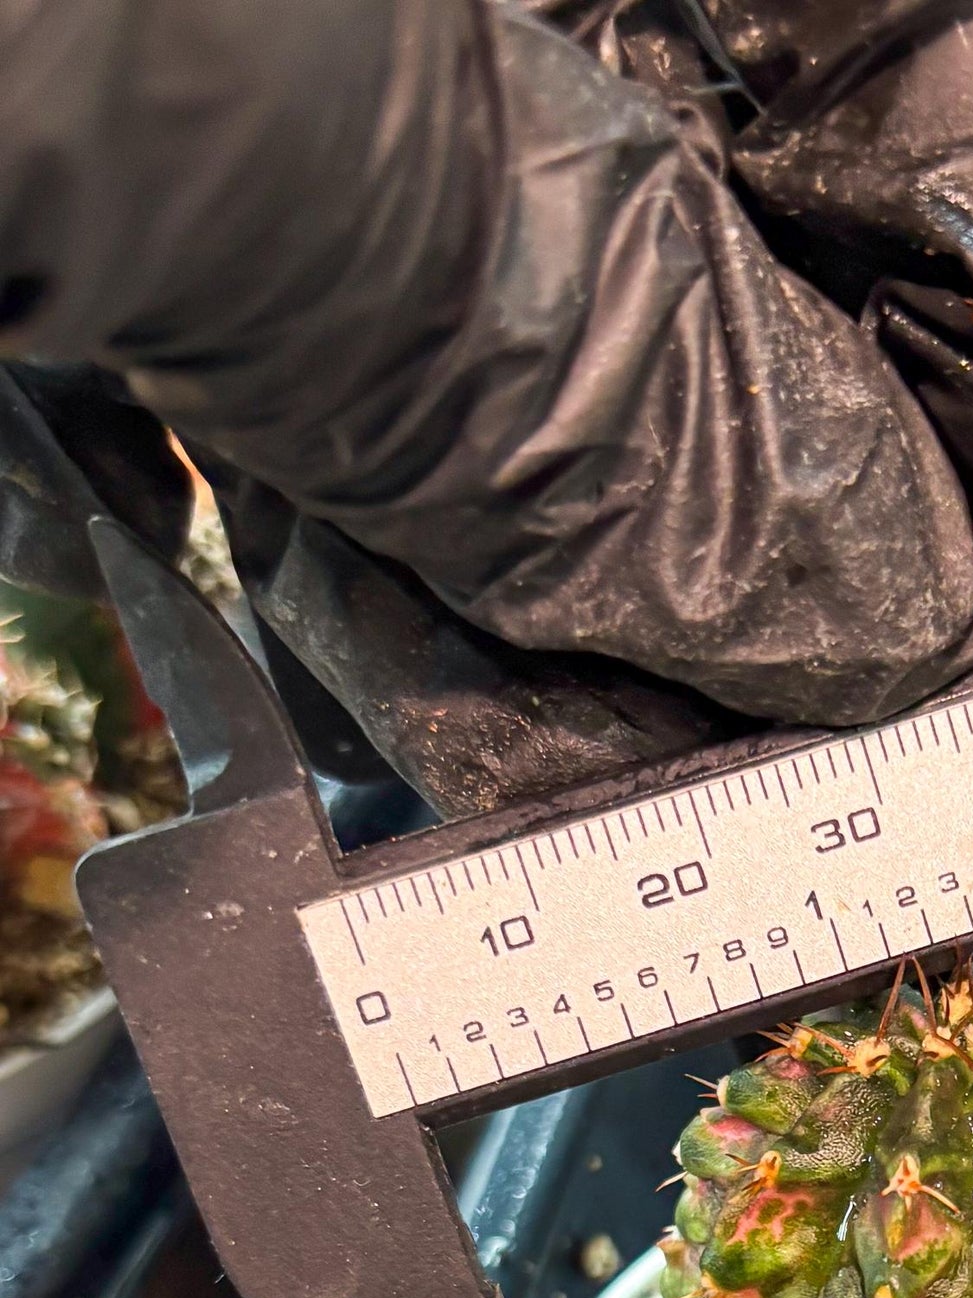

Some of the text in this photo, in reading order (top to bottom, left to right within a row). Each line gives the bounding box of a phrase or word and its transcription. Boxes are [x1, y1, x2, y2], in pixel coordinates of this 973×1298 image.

[355, 990, 391, 1026] 0
[480, 915, 535, 957] 10
[637, 860, 708, 909] 20
[810, 807, 881, 854] 30
[429, 1034, 441, 1052] 1
[463, 1021, 487, 1043] 2
[506, 1006, 529, 1028] 3
[553, 993, 571, 1014] 4
[592, 979, 615, 1002] 5
[637, 966, 659, 989] 6
[683, 952, 700, 974] 7
[722, 939, 747, 962] 8
[766, 926, 789, 950] 9
[804, 890, 824, 920] 1
[862, 899, 874, 918] 1
[895, 886, 918, 908] 2
[938, 871, 960, 893] 3
